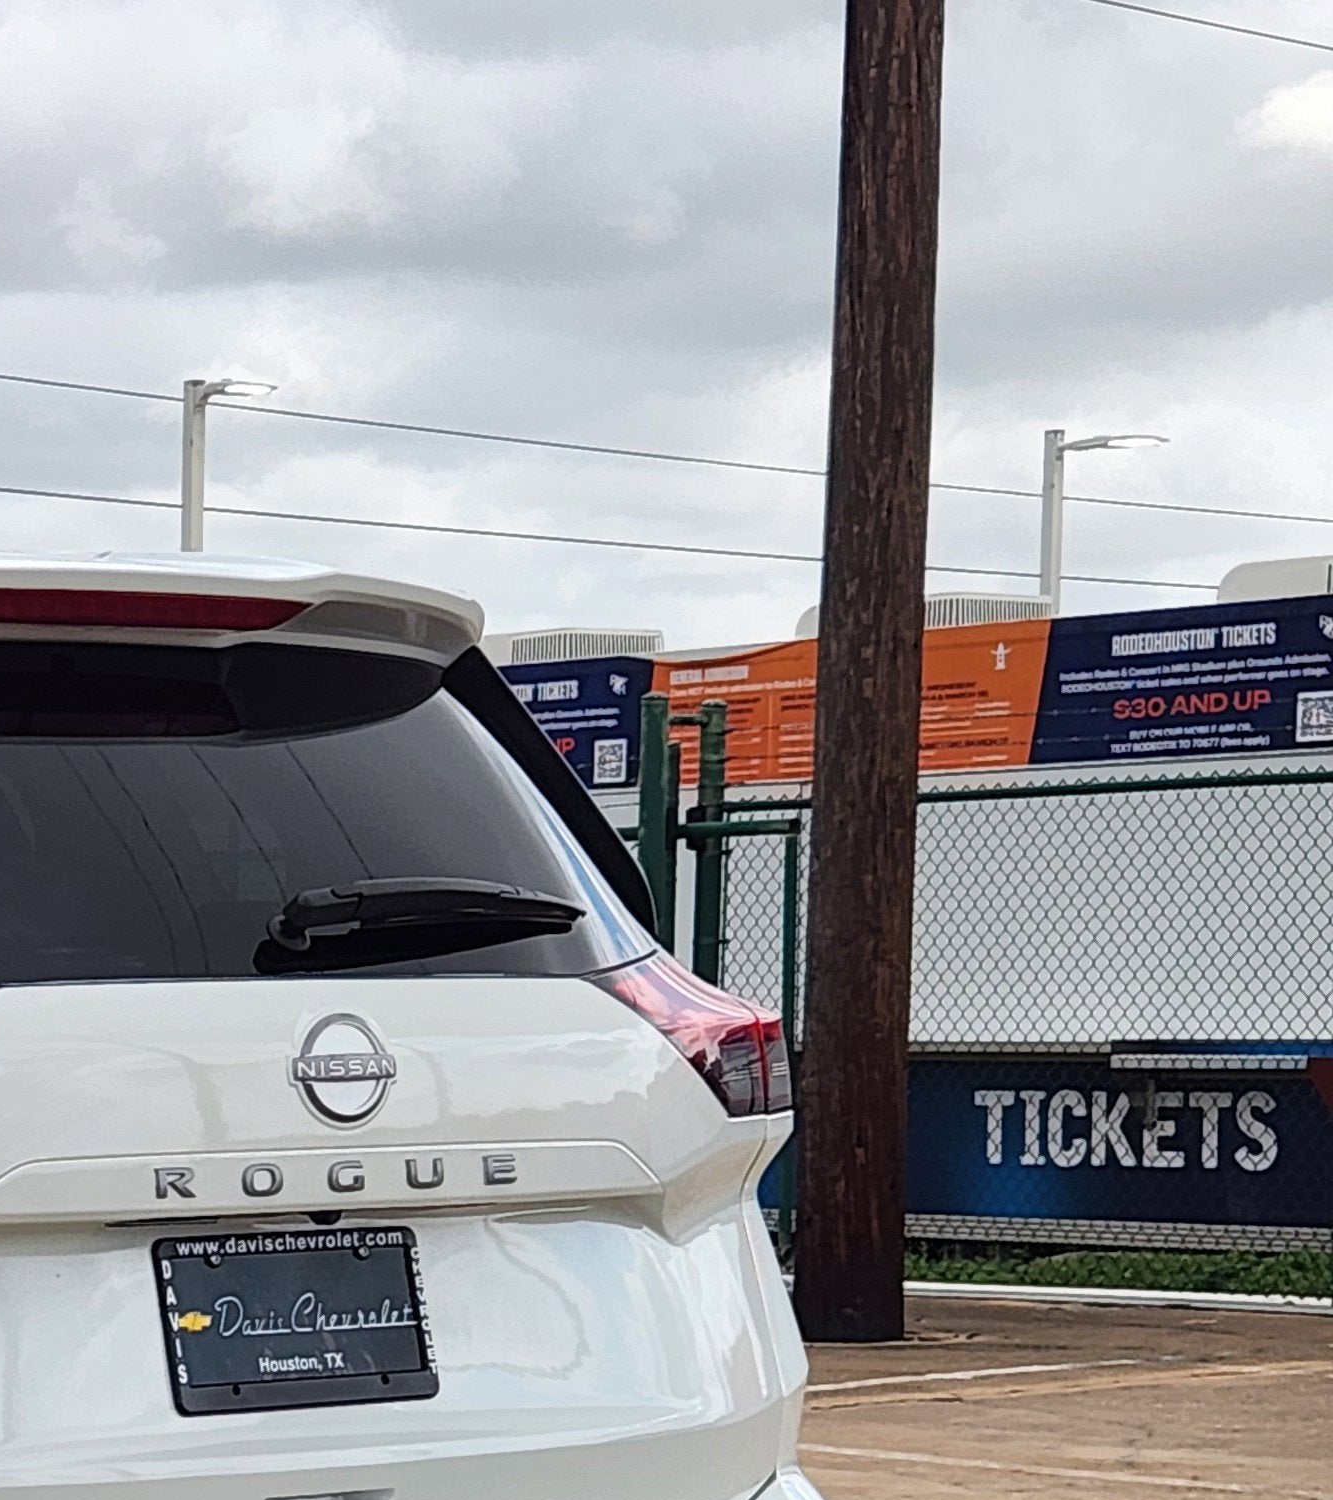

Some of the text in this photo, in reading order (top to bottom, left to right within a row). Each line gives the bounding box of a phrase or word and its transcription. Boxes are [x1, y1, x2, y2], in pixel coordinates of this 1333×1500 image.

[1221, 621, 1276, 649] TICKETS
[1113, 689, 1271, 719] $30 AND UP
[296, 1059, 395, 1078] NISSAN
[974, 1089, 1278, 1171] TICKETS
[153, 1153, 518, 1199] ROGUE
[176, 1230, 404, 1256] www.davischevrolet.com
[161, 1259, 188, 1384] DAVIS
[214, 1292, 418, 1337] Davis Chevrolet
[258, 1352, 345, 1373] Houston, TX
